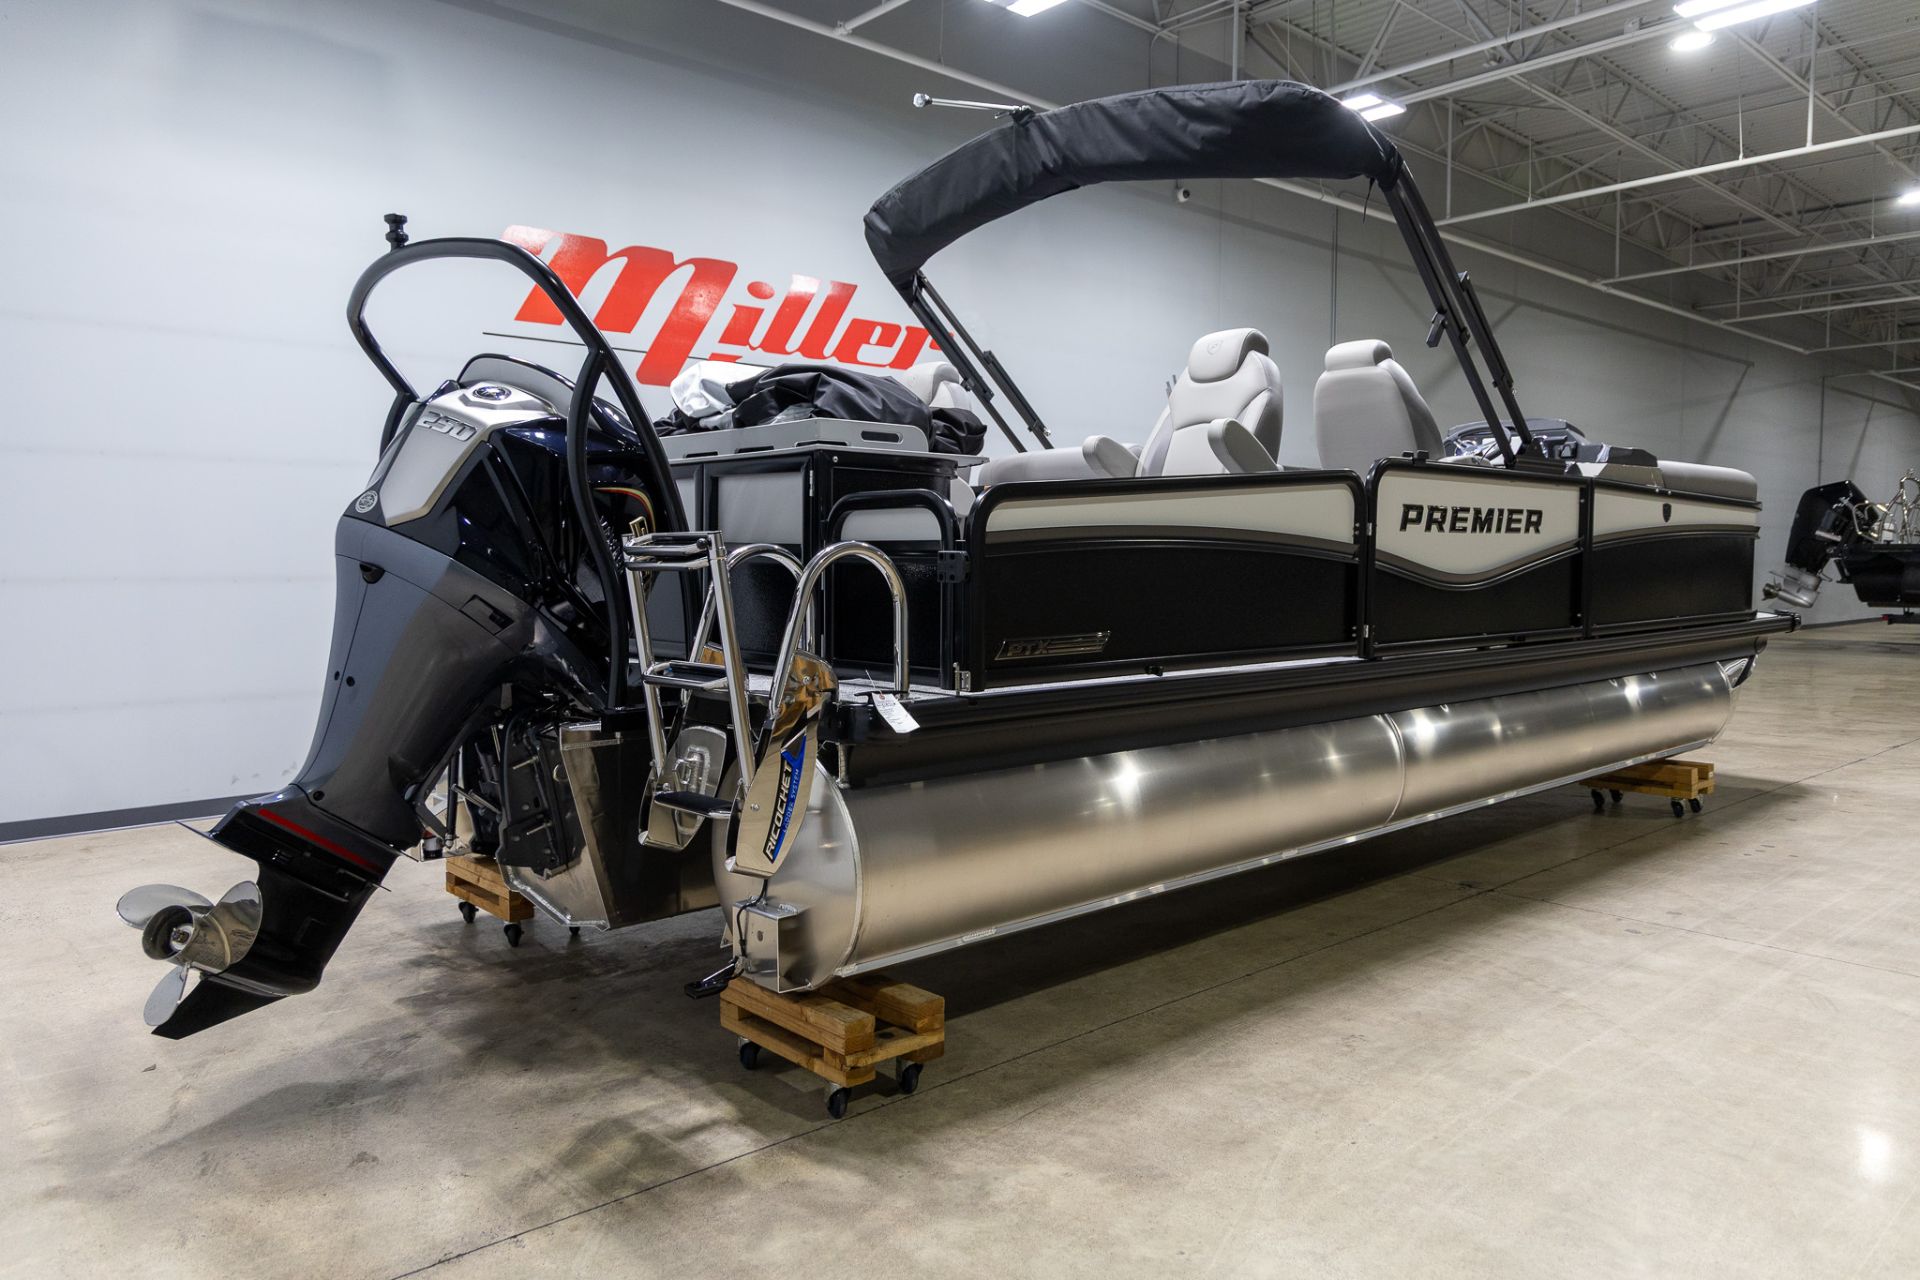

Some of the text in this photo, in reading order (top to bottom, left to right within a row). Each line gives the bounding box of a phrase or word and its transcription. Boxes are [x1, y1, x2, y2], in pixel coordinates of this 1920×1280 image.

[416, 410, 477, 441] 250
[1400, 503, 1543, 534] PREMIER
[790, 769, 799, 799] SYSTEM
[765, 760, 792, 860] RICOCHET
